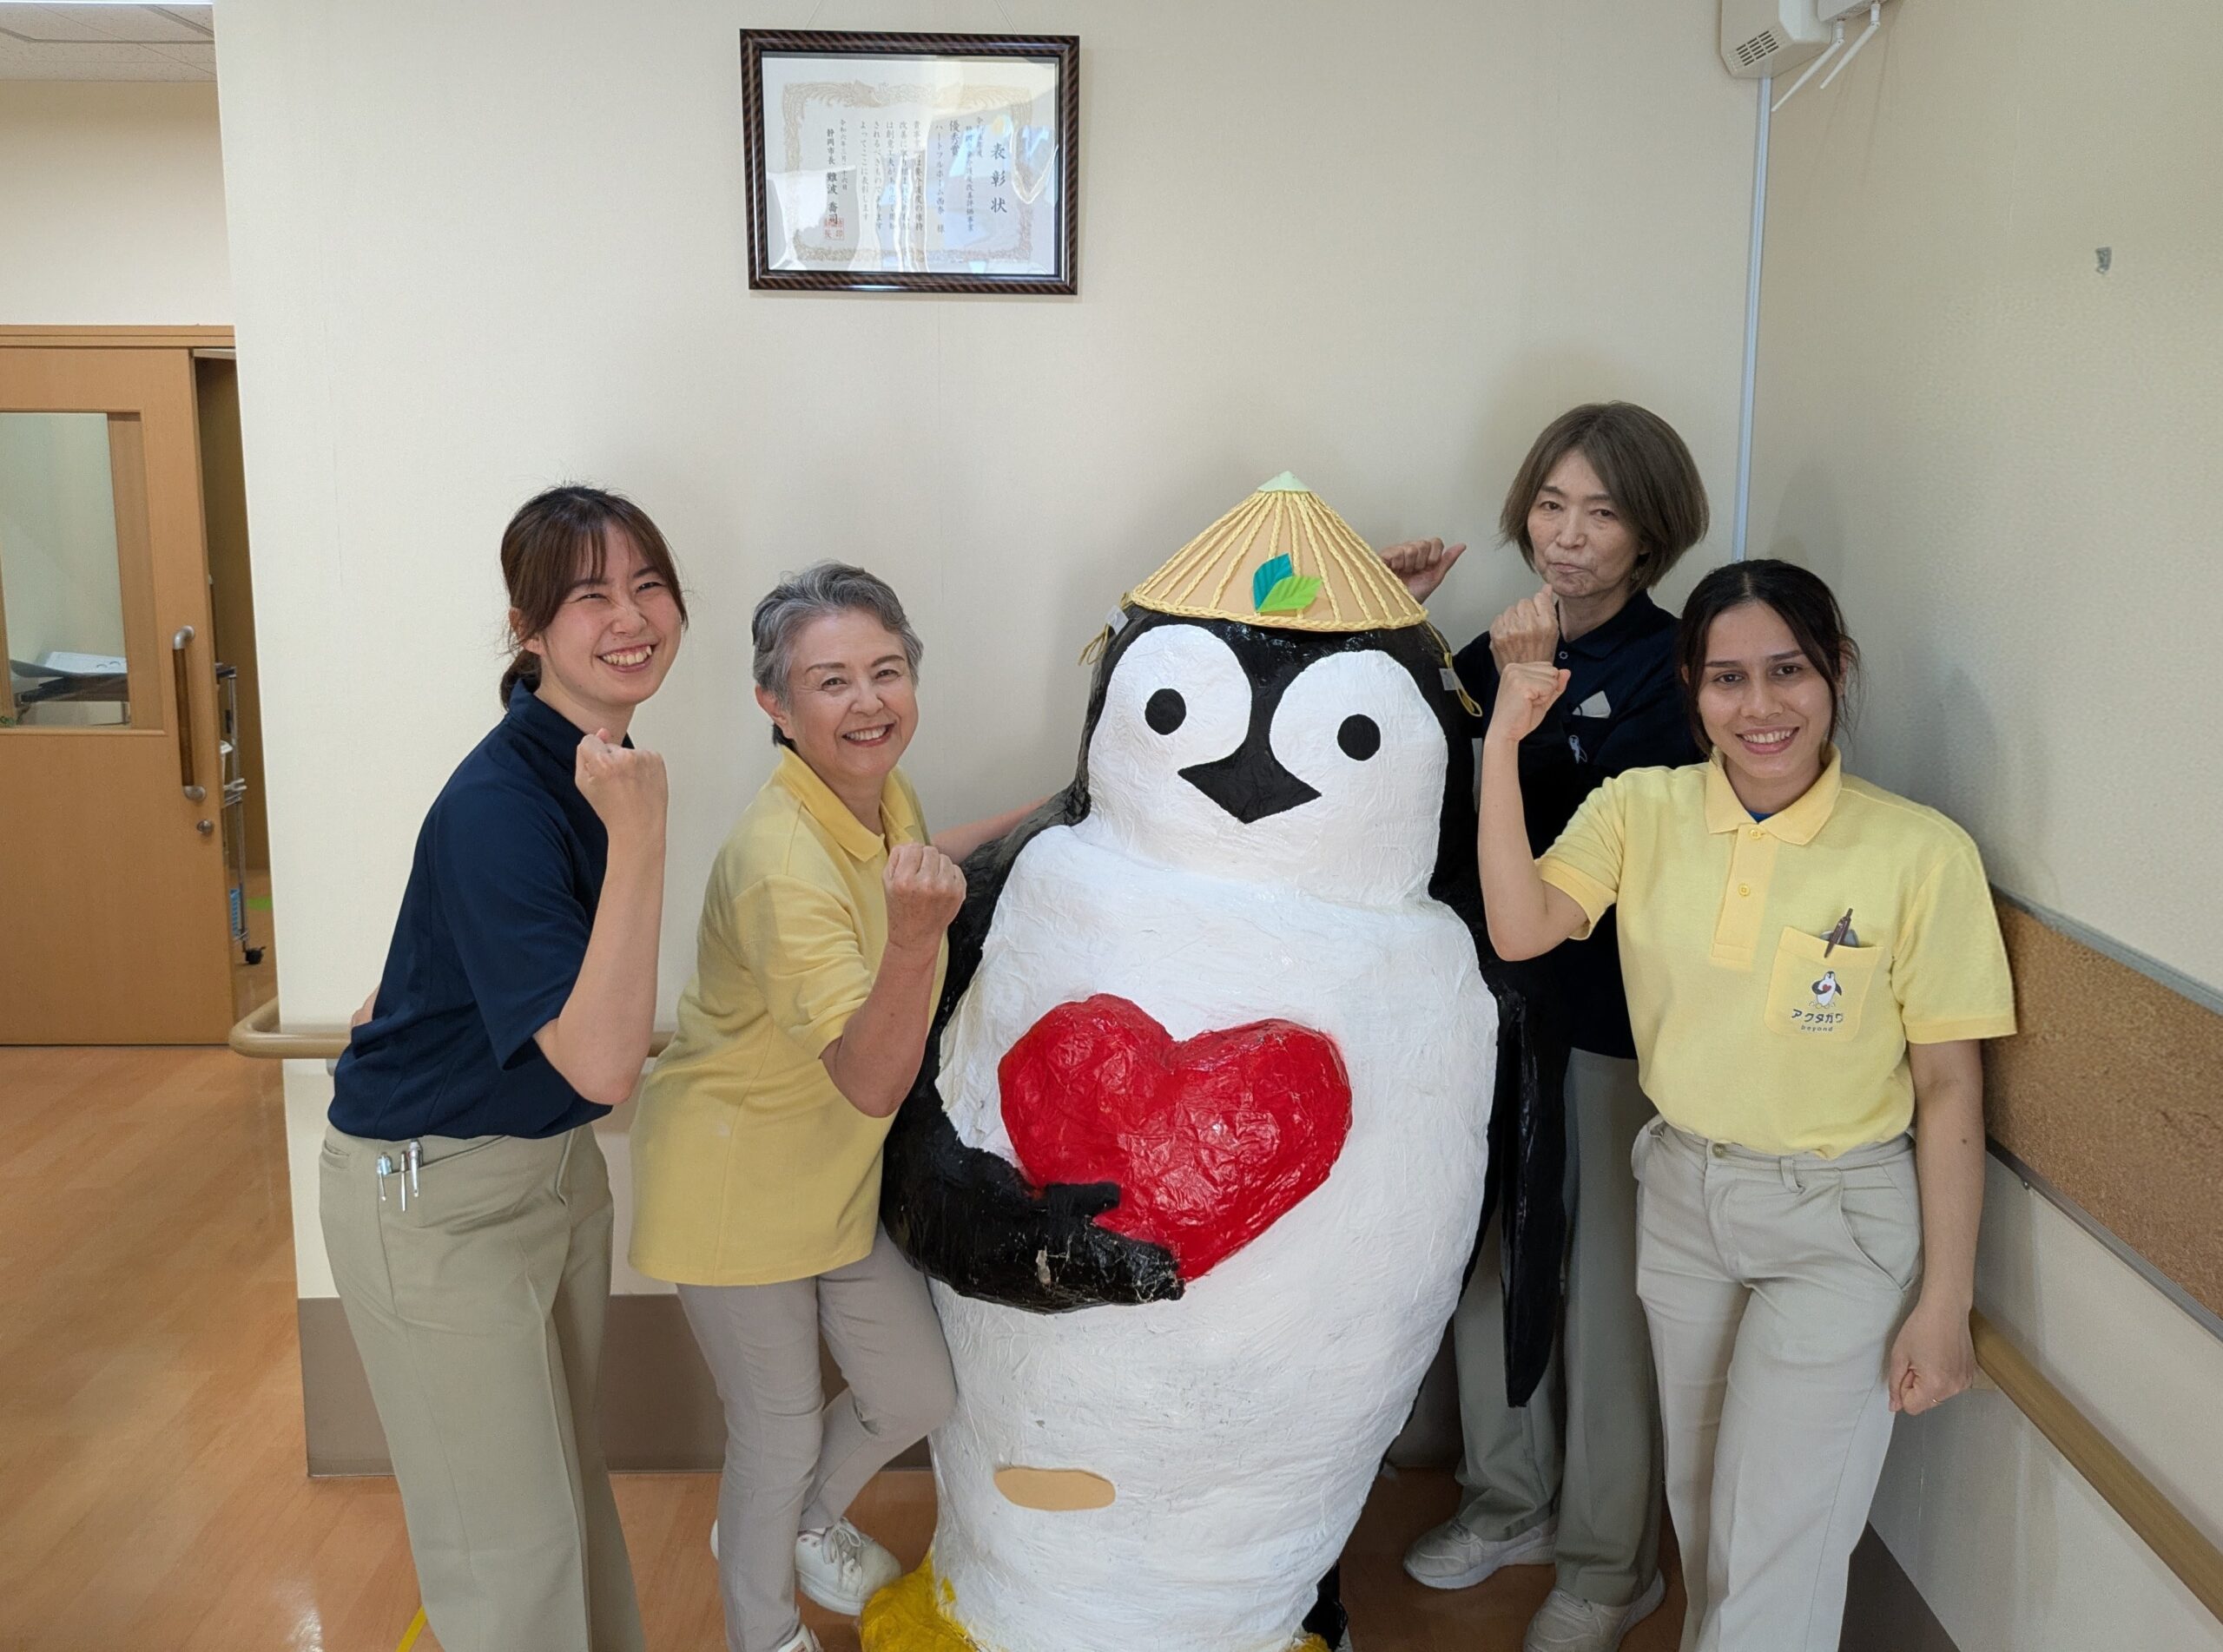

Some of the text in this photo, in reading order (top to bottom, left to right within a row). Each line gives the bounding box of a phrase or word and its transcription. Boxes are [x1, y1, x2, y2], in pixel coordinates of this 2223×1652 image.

[827, 128, 835, 165] 静岡市長
[949, 120, 960, 156] 優秀賞
[826, 172, 838, 195] 難波
[990, 142, 1008, 214] 表彰状
[1791, 1009, 1844, 1023] アクタガワ
